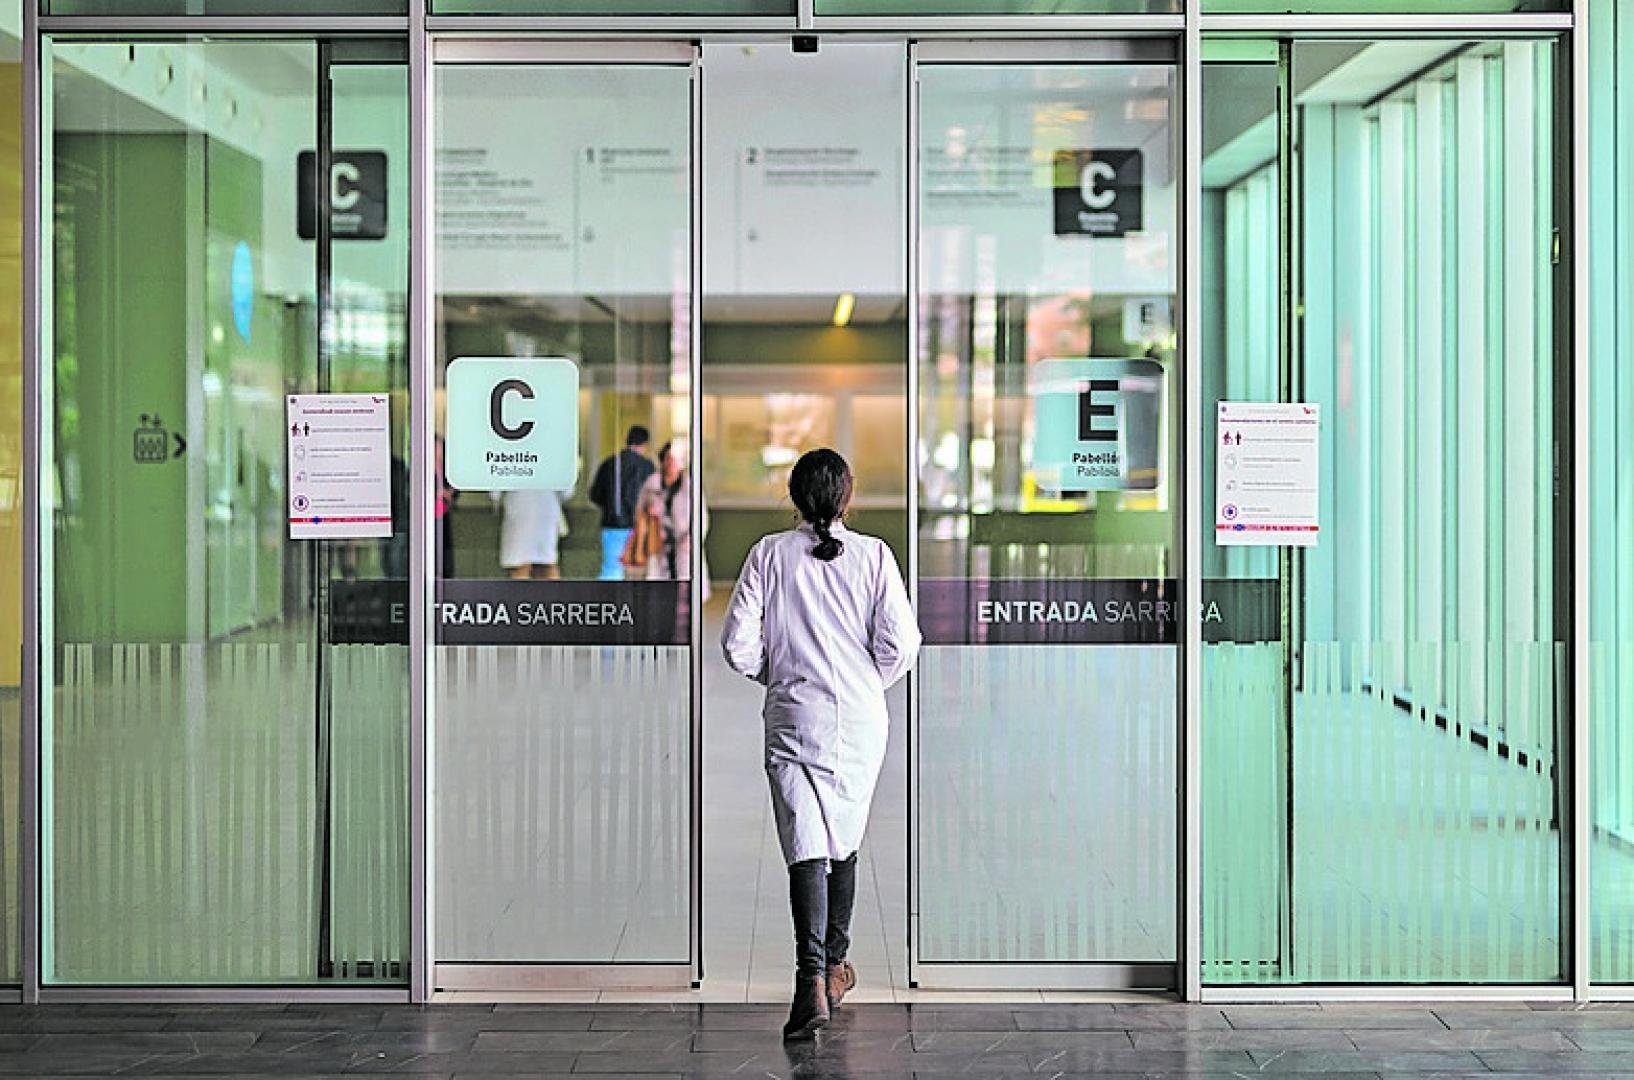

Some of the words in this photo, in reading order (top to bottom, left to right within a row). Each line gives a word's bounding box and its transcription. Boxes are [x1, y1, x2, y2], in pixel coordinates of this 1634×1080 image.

[331, 162, 360, 210] C
[1080, 161, 1117, 209] C
[490, 379, 535, 440] C
[1078, 380, 1119, 441] E
[486, 450, 538, 462] Pabellón
[1072, 450, 1121, 464] Pabelló
[389, 602, 511, 625] ERADA
[516, 602, 634, 625] SARRERA
[976, 600, 1099, 623] ENTRADA
